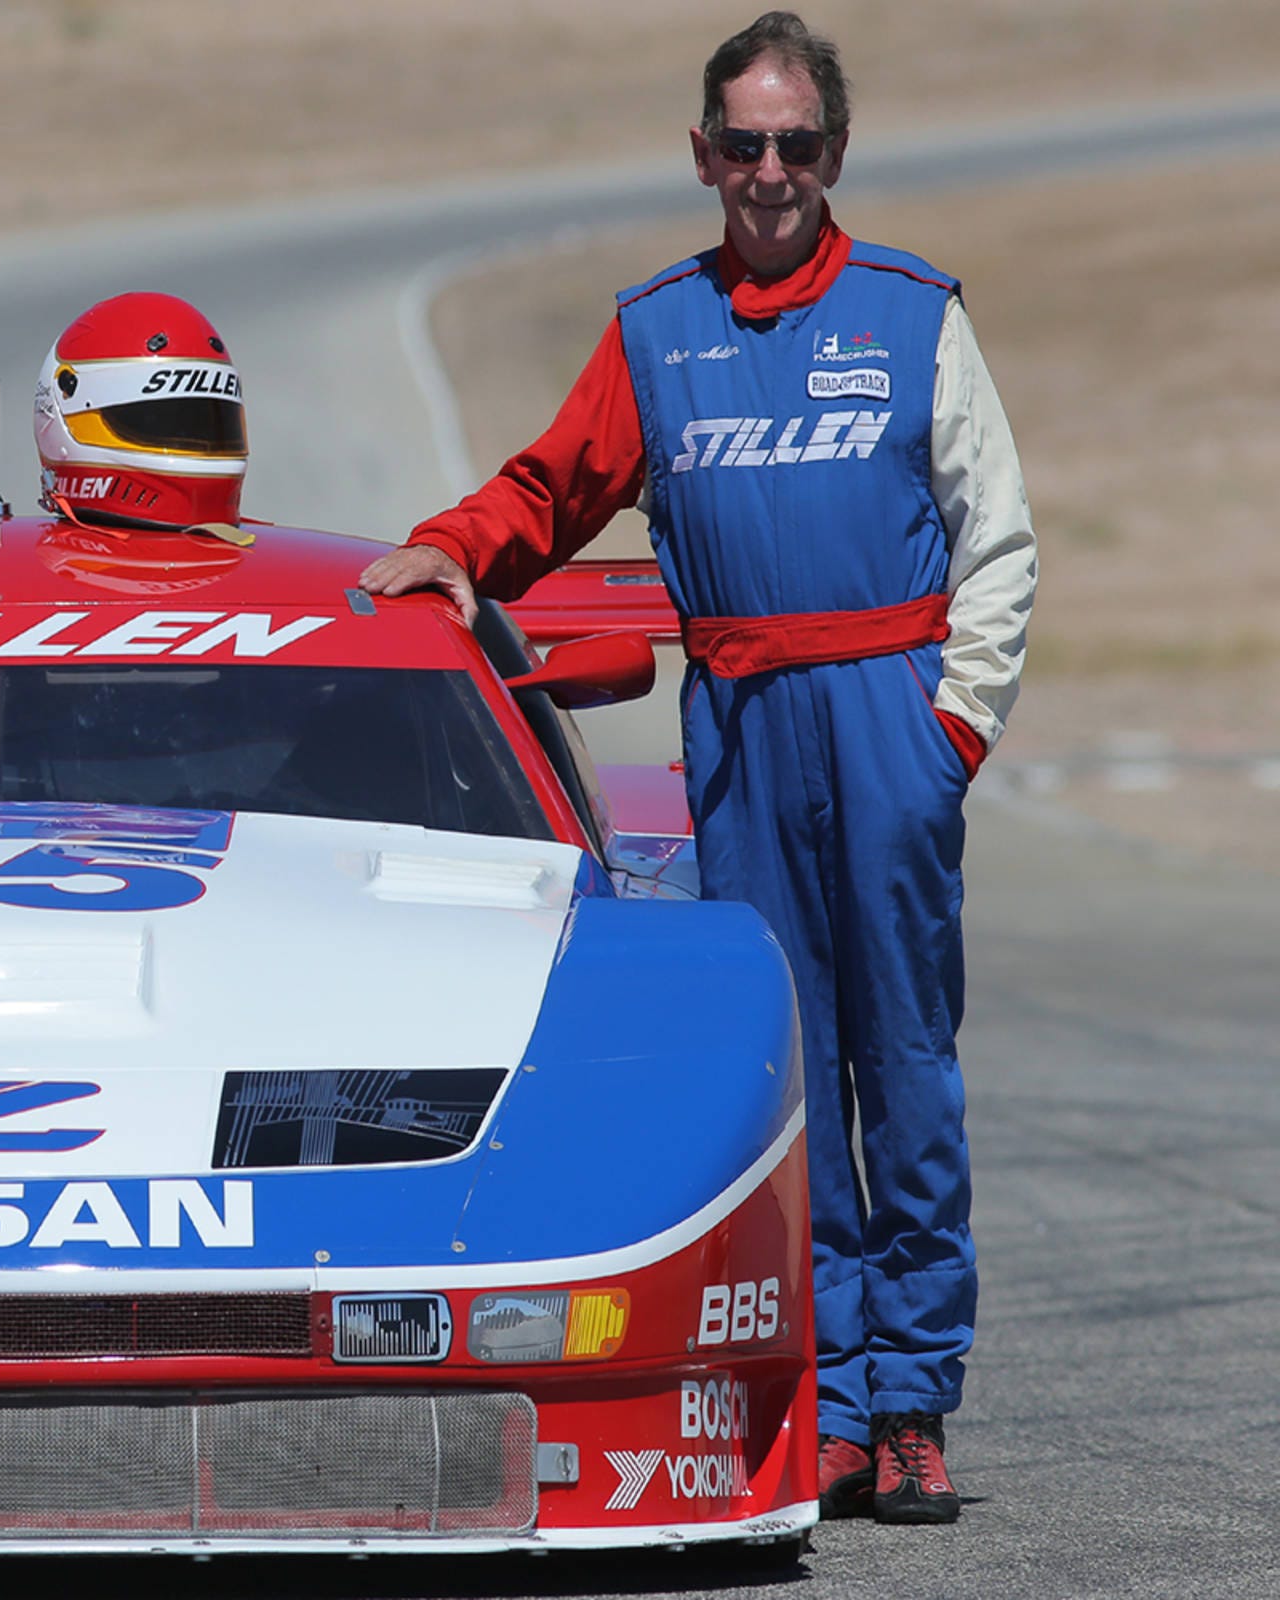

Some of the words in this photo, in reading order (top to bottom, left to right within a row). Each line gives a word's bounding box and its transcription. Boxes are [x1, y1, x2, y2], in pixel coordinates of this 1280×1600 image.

[854, 374, 887, 394] TRACK
[671, 410, 893, 474] STILLEN
[55, 476, 114, 498] ILLEN
[697, 1276, 780, 1346] BBS
[681, 1379, 749, 1440] BOSCH
[664, 1454, 753, 1499] YOKOHAMA
